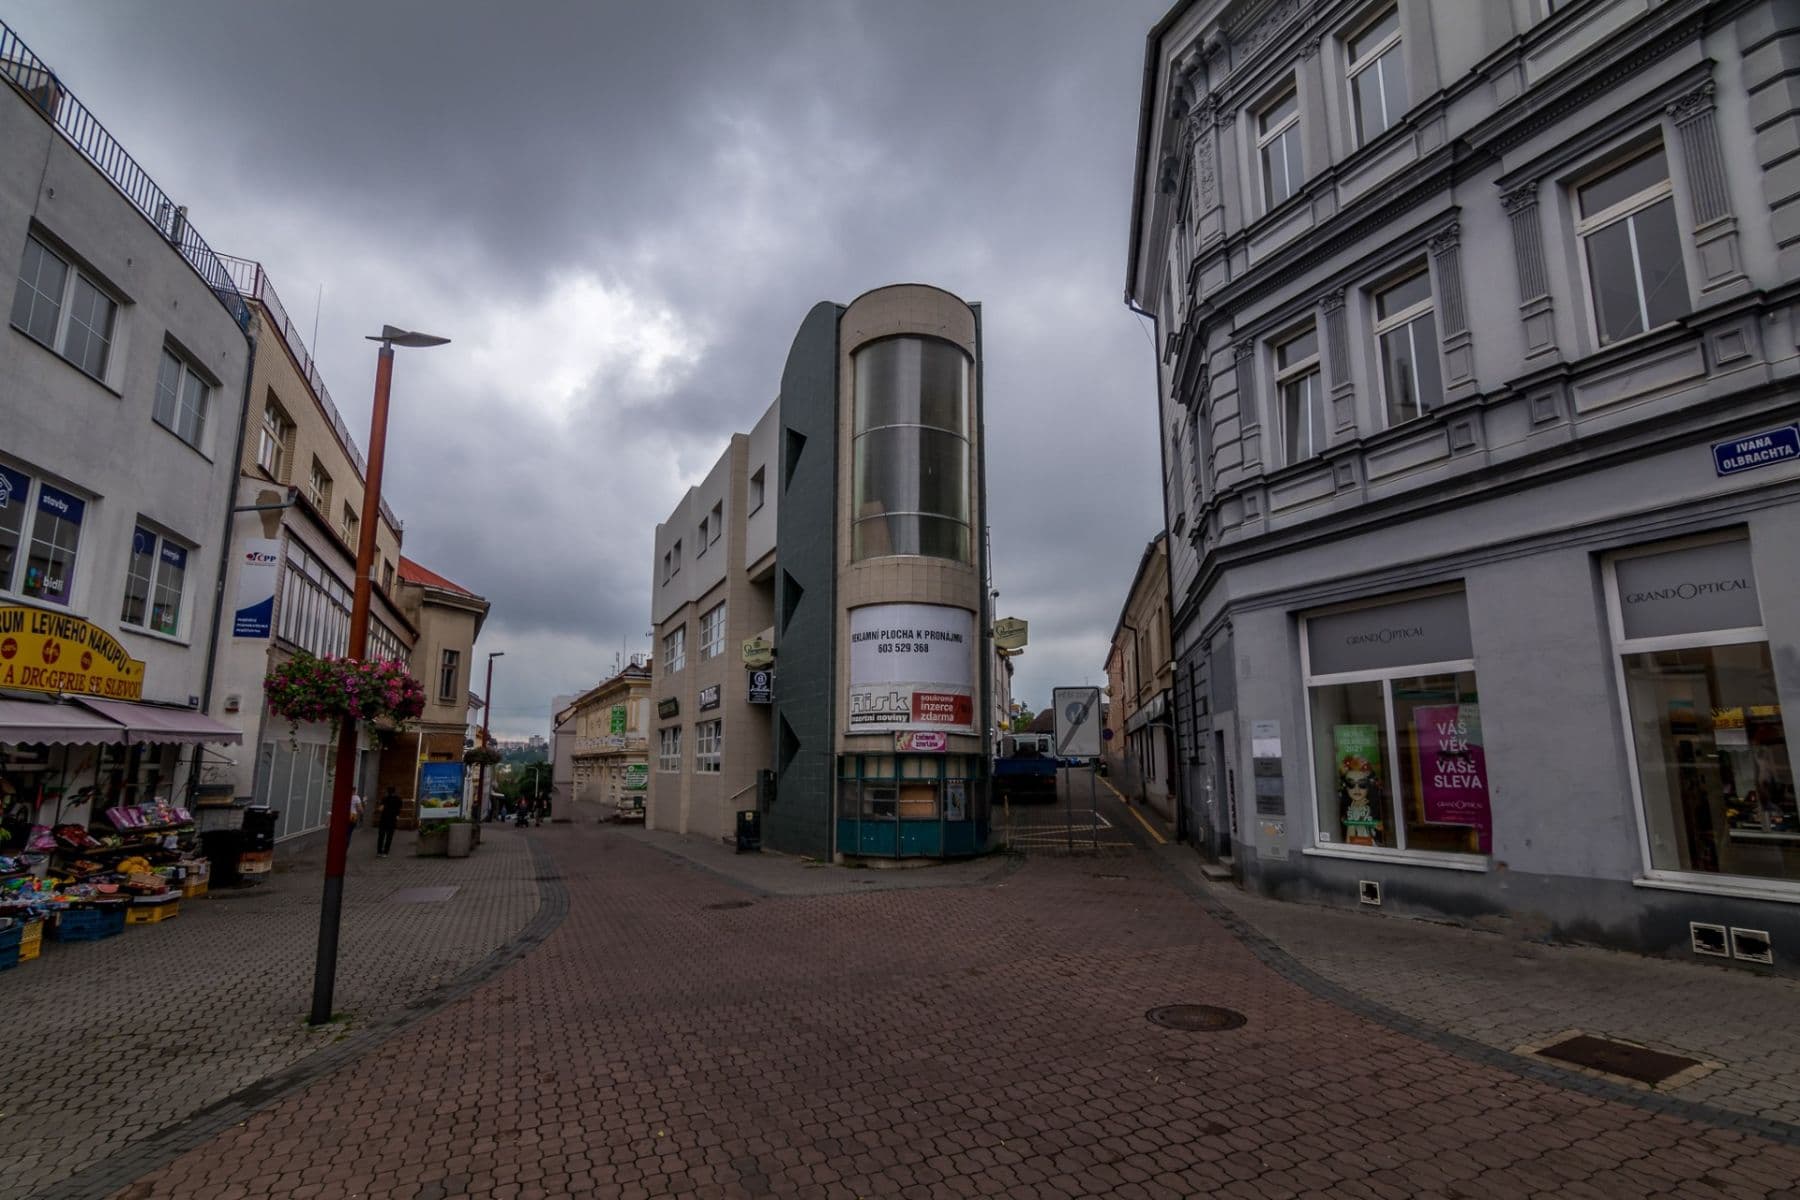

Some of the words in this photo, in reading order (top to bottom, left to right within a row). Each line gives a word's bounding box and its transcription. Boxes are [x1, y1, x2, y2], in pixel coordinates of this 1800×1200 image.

[1736, 436, 1773, 454] IVANA
[1722, 444, 1794, 470] OLBRACHTA
[1626, 578, 1752, 604] GRANDOPTICAL
[881, 629, 914, 640] PLOCHA
[917, 630, 923, 640] K
[878, 643, 893, 653] 603
[895, 643, 911, 653] 529
[104, 677, 141, 699] SLEVOU
[851, 692, 909, 713] Risk
[877, 714, 908, 722] noviny
[920, 711, 954, 721] zdarma
[1437, 720, 1467, 735] VÁŠ
[1439, 736, 1469, 752] VĚK
[1434, 775, 1483, 789] SLEVA
